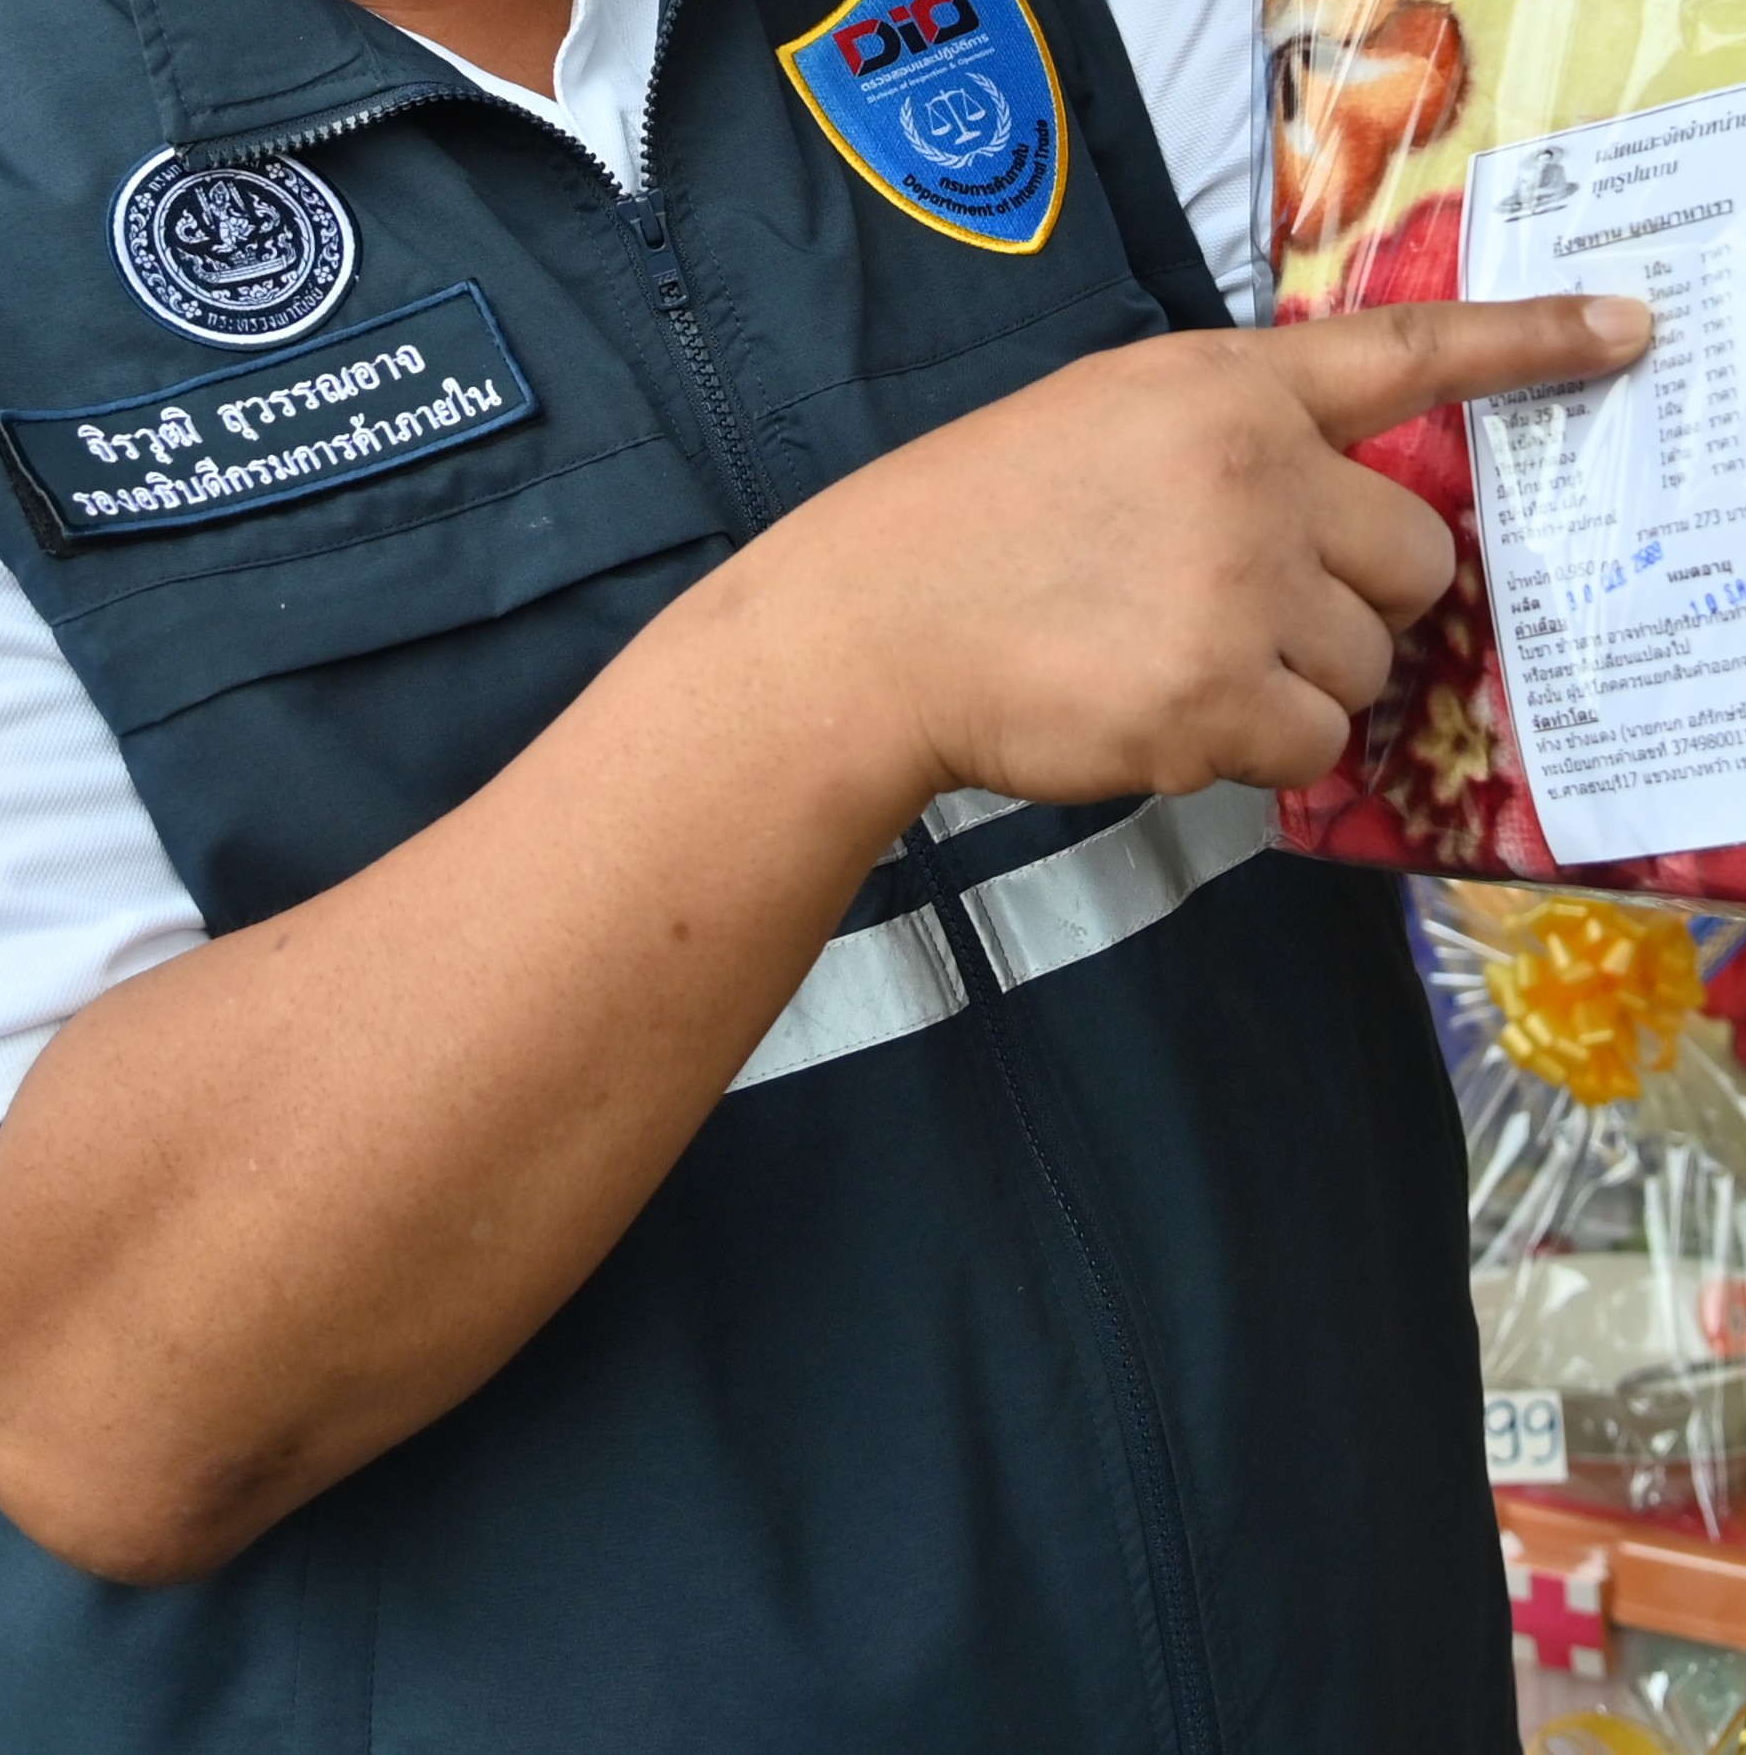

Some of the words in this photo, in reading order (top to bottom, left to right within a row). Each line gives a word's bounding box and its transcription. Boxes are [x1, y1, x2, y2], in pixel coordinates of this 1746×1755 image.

[903, 173, 995, 218] Department
[1010, 159, 1048, 208] Internal
[1037, 117, 1051, 160] Trade
[72, 376, 504, 518] รองอธิบดีกรมการค้าภายใน
[77, 406, 204, 466] จิรวุฒิ
[217, 344, 427, 442] สุวรรณอาจ
[1693, 507, 1722, 529] 273
[1484, 1399, 1561, 1467] 99
